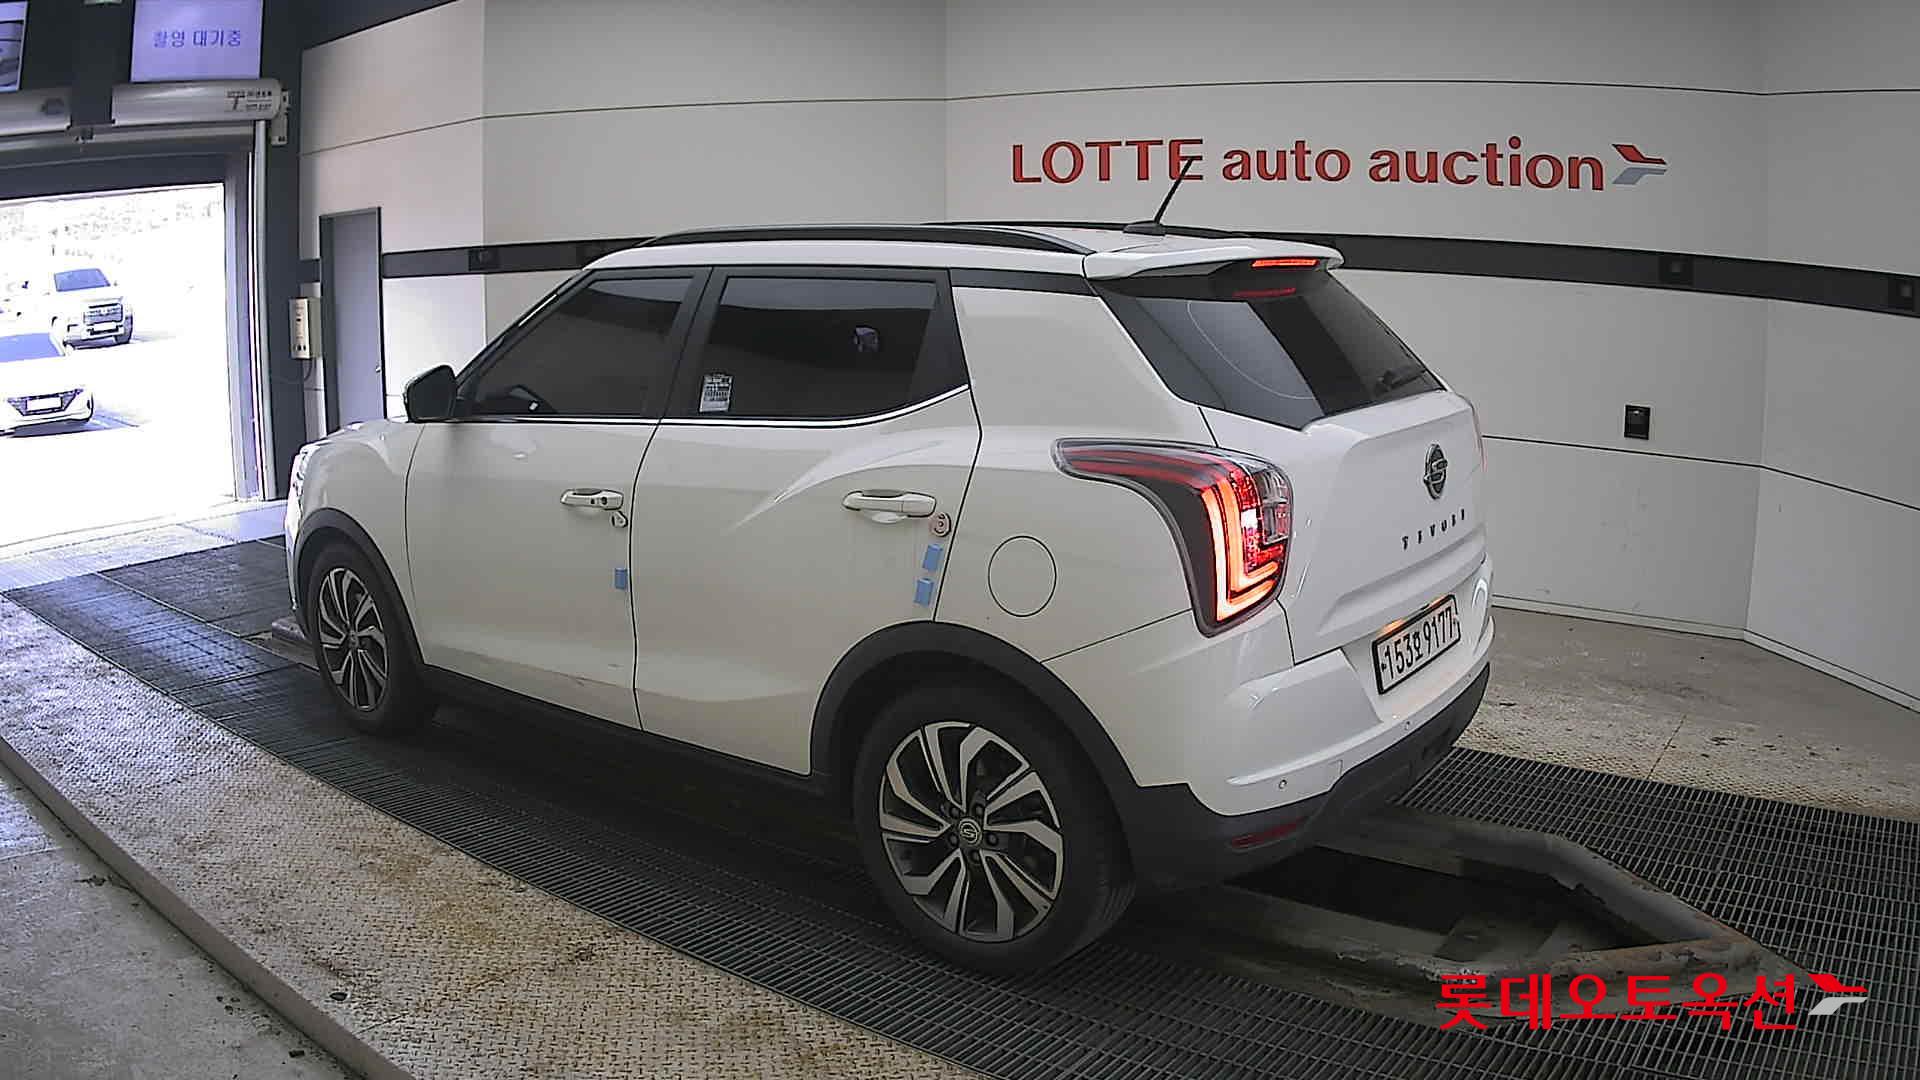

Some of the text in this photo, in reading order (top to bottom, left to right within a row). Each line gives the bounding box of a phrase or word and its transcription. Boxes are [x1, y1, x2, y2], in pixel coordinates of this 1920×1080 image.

[192, 29, 241, 48] 대기중
[1012, 136, 1605, 191] LOTTE auto auction
